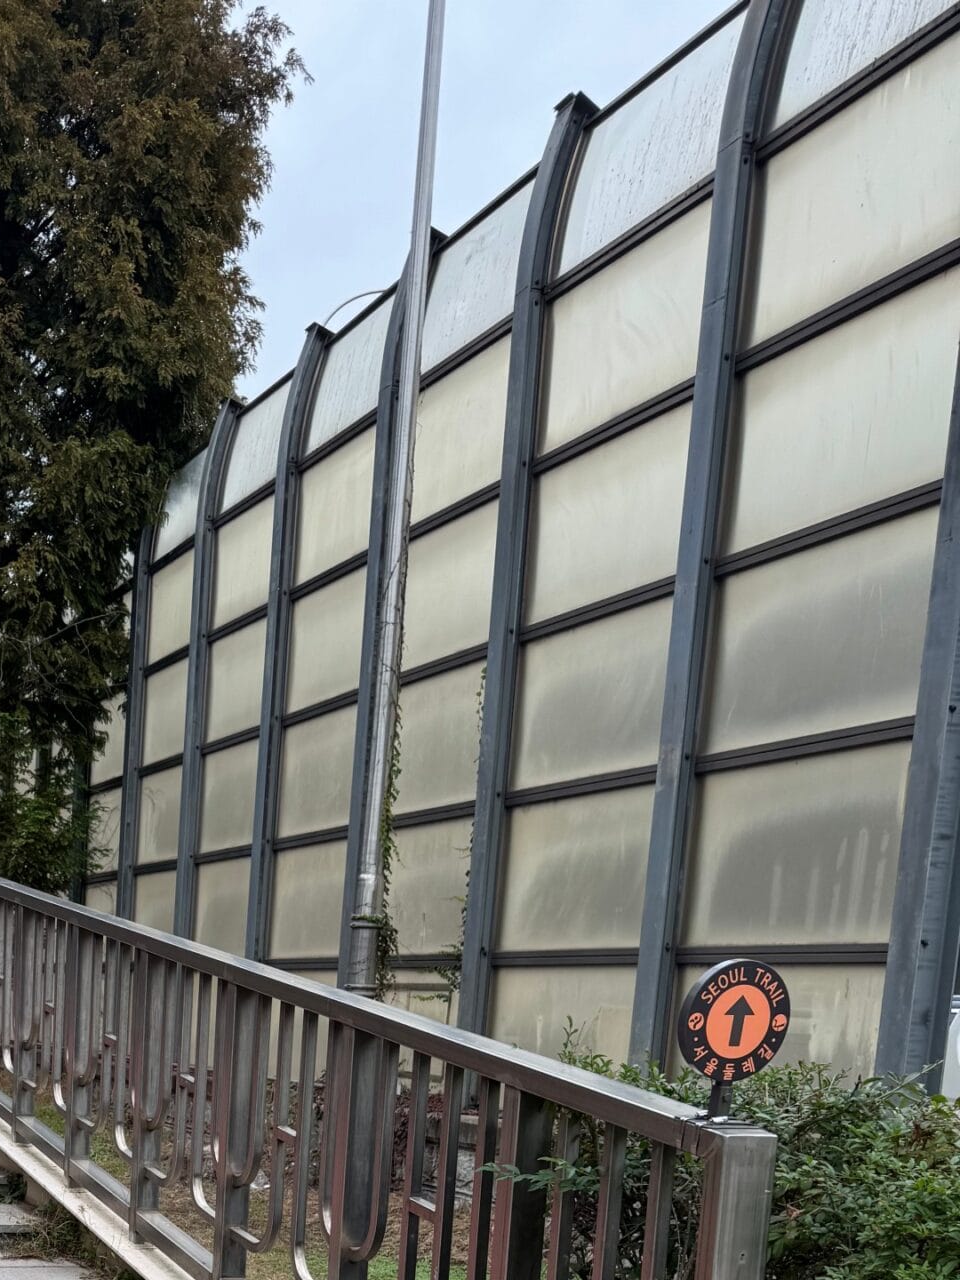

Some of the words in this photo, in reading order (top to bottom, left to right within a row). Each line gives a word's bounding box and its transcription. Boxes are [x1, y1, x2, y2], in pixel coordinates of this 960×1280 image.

[701, 966, 748, 1004] SEOUL
[754, 967, 785, 1007] TRAIL
[693, 1043, 774, 1080] 서울둘레길
